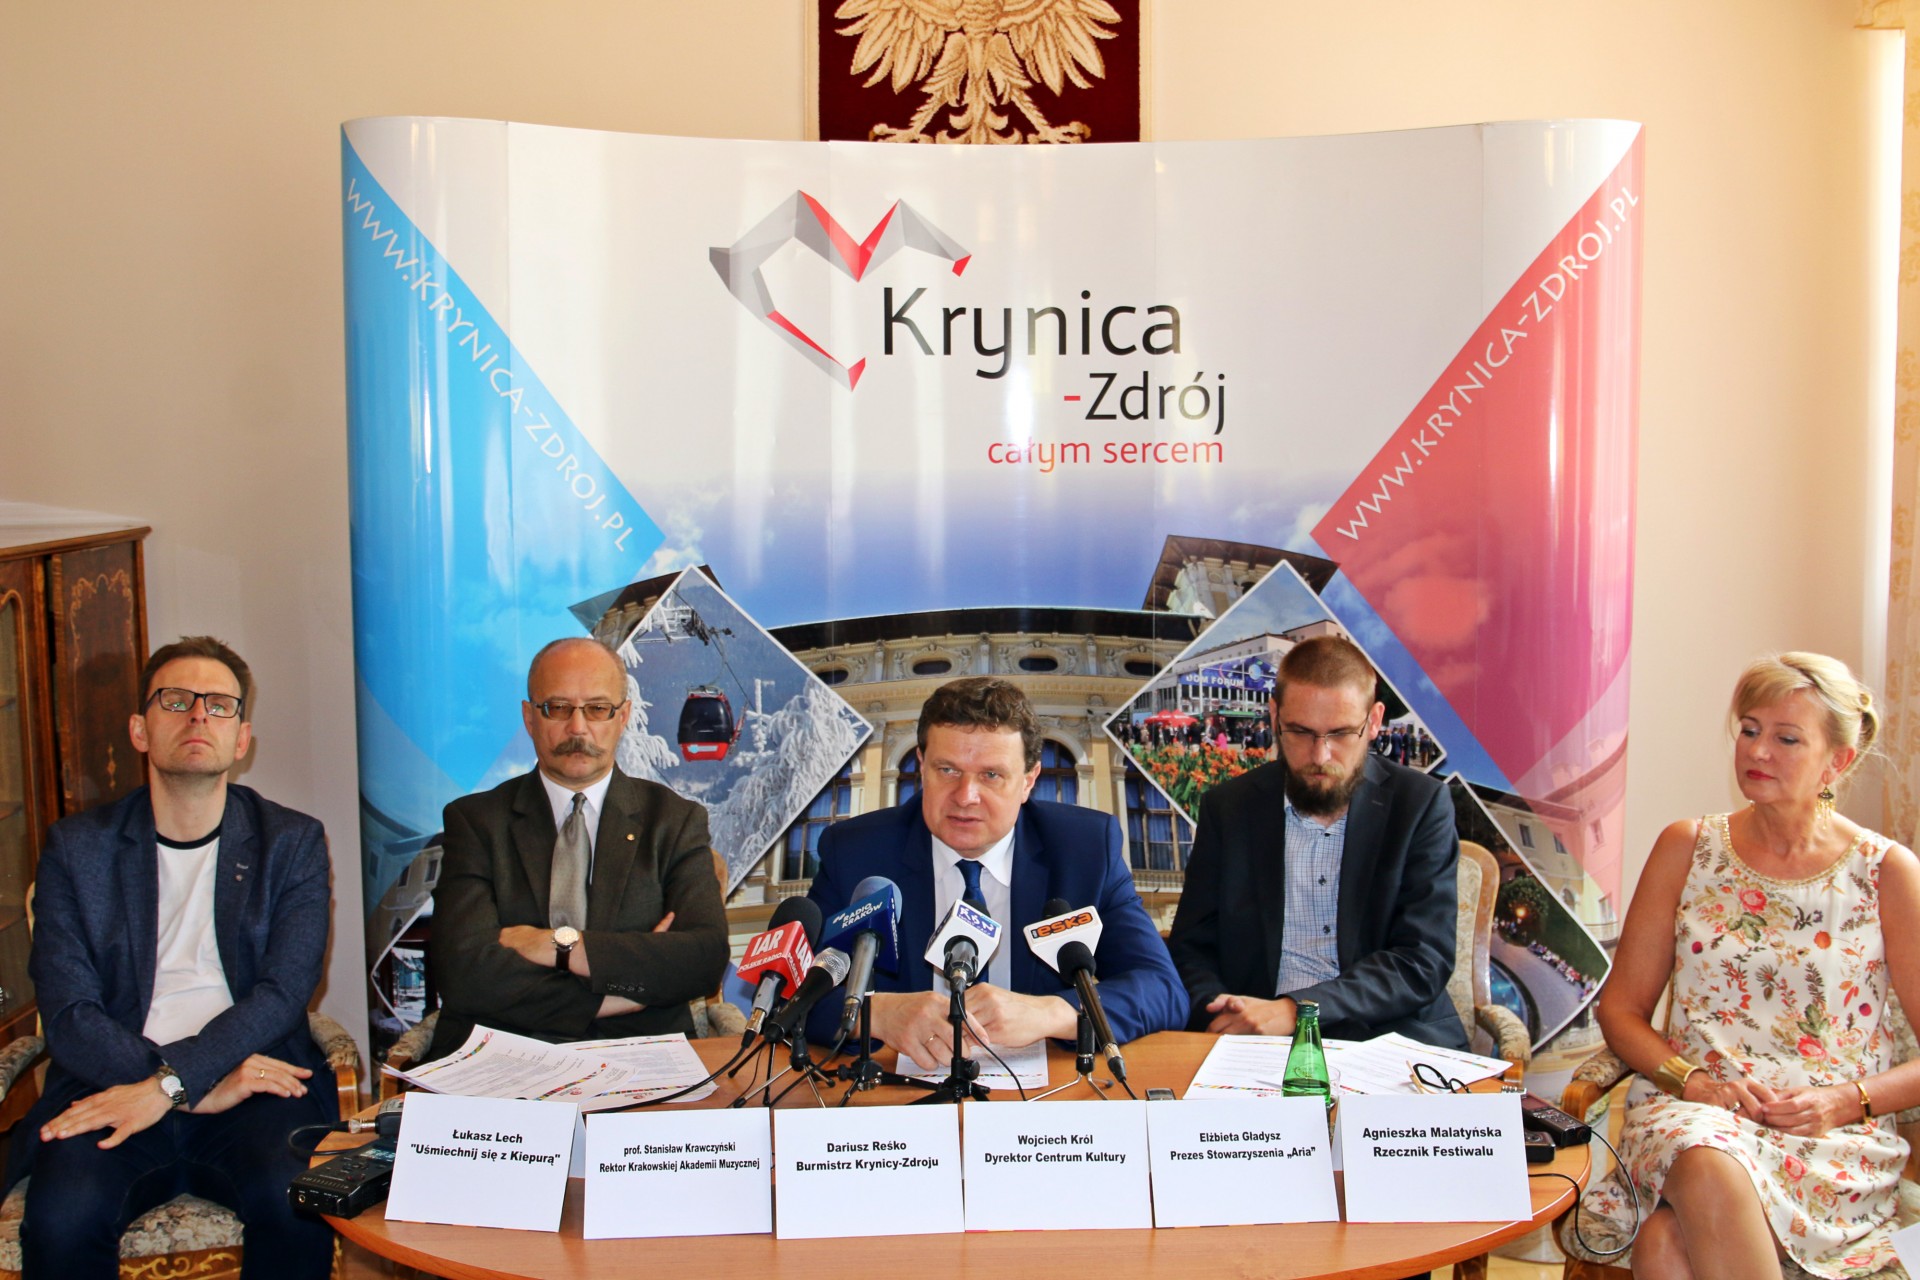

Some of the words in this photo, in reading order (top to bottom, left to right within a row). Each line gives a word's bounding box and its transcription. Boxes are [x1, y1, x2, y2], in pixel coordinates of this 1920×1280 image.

[884, 287, 1181, 379] Krynica
[347, 178, 635, 552] WWW.KRYNICA-ZDROJ.PL
[1336, 187, 1638, 541] WWW.KRYNICA-ZDROJ.PL
[1064, 370, 1226, 435] -Zdrój
[988, 437, 1090, 473] całym
[1103, 440, 1223, 464] sercem
[843, 903, 872, 922] RADIO
[751, 929, 784, 957] IAR
[795, 933, 812, 978] IAR
[452, 1129, 492, 1142] Łukasz
[495, 1132, 523, 1144] Lech
[1018, 1134, 1067, 1147] Wojciech
[1070, 1134, 1093, 1145] Król
[1199, 1132, 1240, 1143] Elżbieta
[1242, 1131, 1281, 1143] Gładysz
[1362, 1127, 1427, 1140] Agnieszka
[1430, 1126, 1502, 1140] Malatyńska
[624, 1145, 642, 1157] prof.
[644, 1143, 683, 1155] Stanisław
[685, 1141, 736, 1154] Krawczyński
[827, 1142, 869, 1153] Dariusz
[872, 1140, 907, 1151] Reśko
[1373, 1146, 1429, 1157] Rzecznik
[1433, 1145, 1494, 1157] Festiwalu
[411, 1144, 478, 1161] "Uśmiechnij
[481, 1149, 498, 1162] się
[500, 1152, 507, 1160] z
[510, 1151, 561, 1166] Kiepurą"
[984, 1152, 1032, 1165] Dyrektor
[1035, 1152, 1082, 1162] Centrum
[1085, 1151, 1126, 1164] Kultury
[1170, 1150, 1204, 1160] Prezes
[1207, 1148, 1284, 1161] Stowarzyszenia
[599, 1162, 626, 1173] Rektor
[628, 1160, 678, 1173] Krakowskiej
[680, 1159, 717, 1170] Akademii
[719, 1158, 760, 1171] Muzycznej
[796, 1160, 852, 1171] Burmistrz
[855, 1156, 939, 1171] Krynicy-Zdroju
